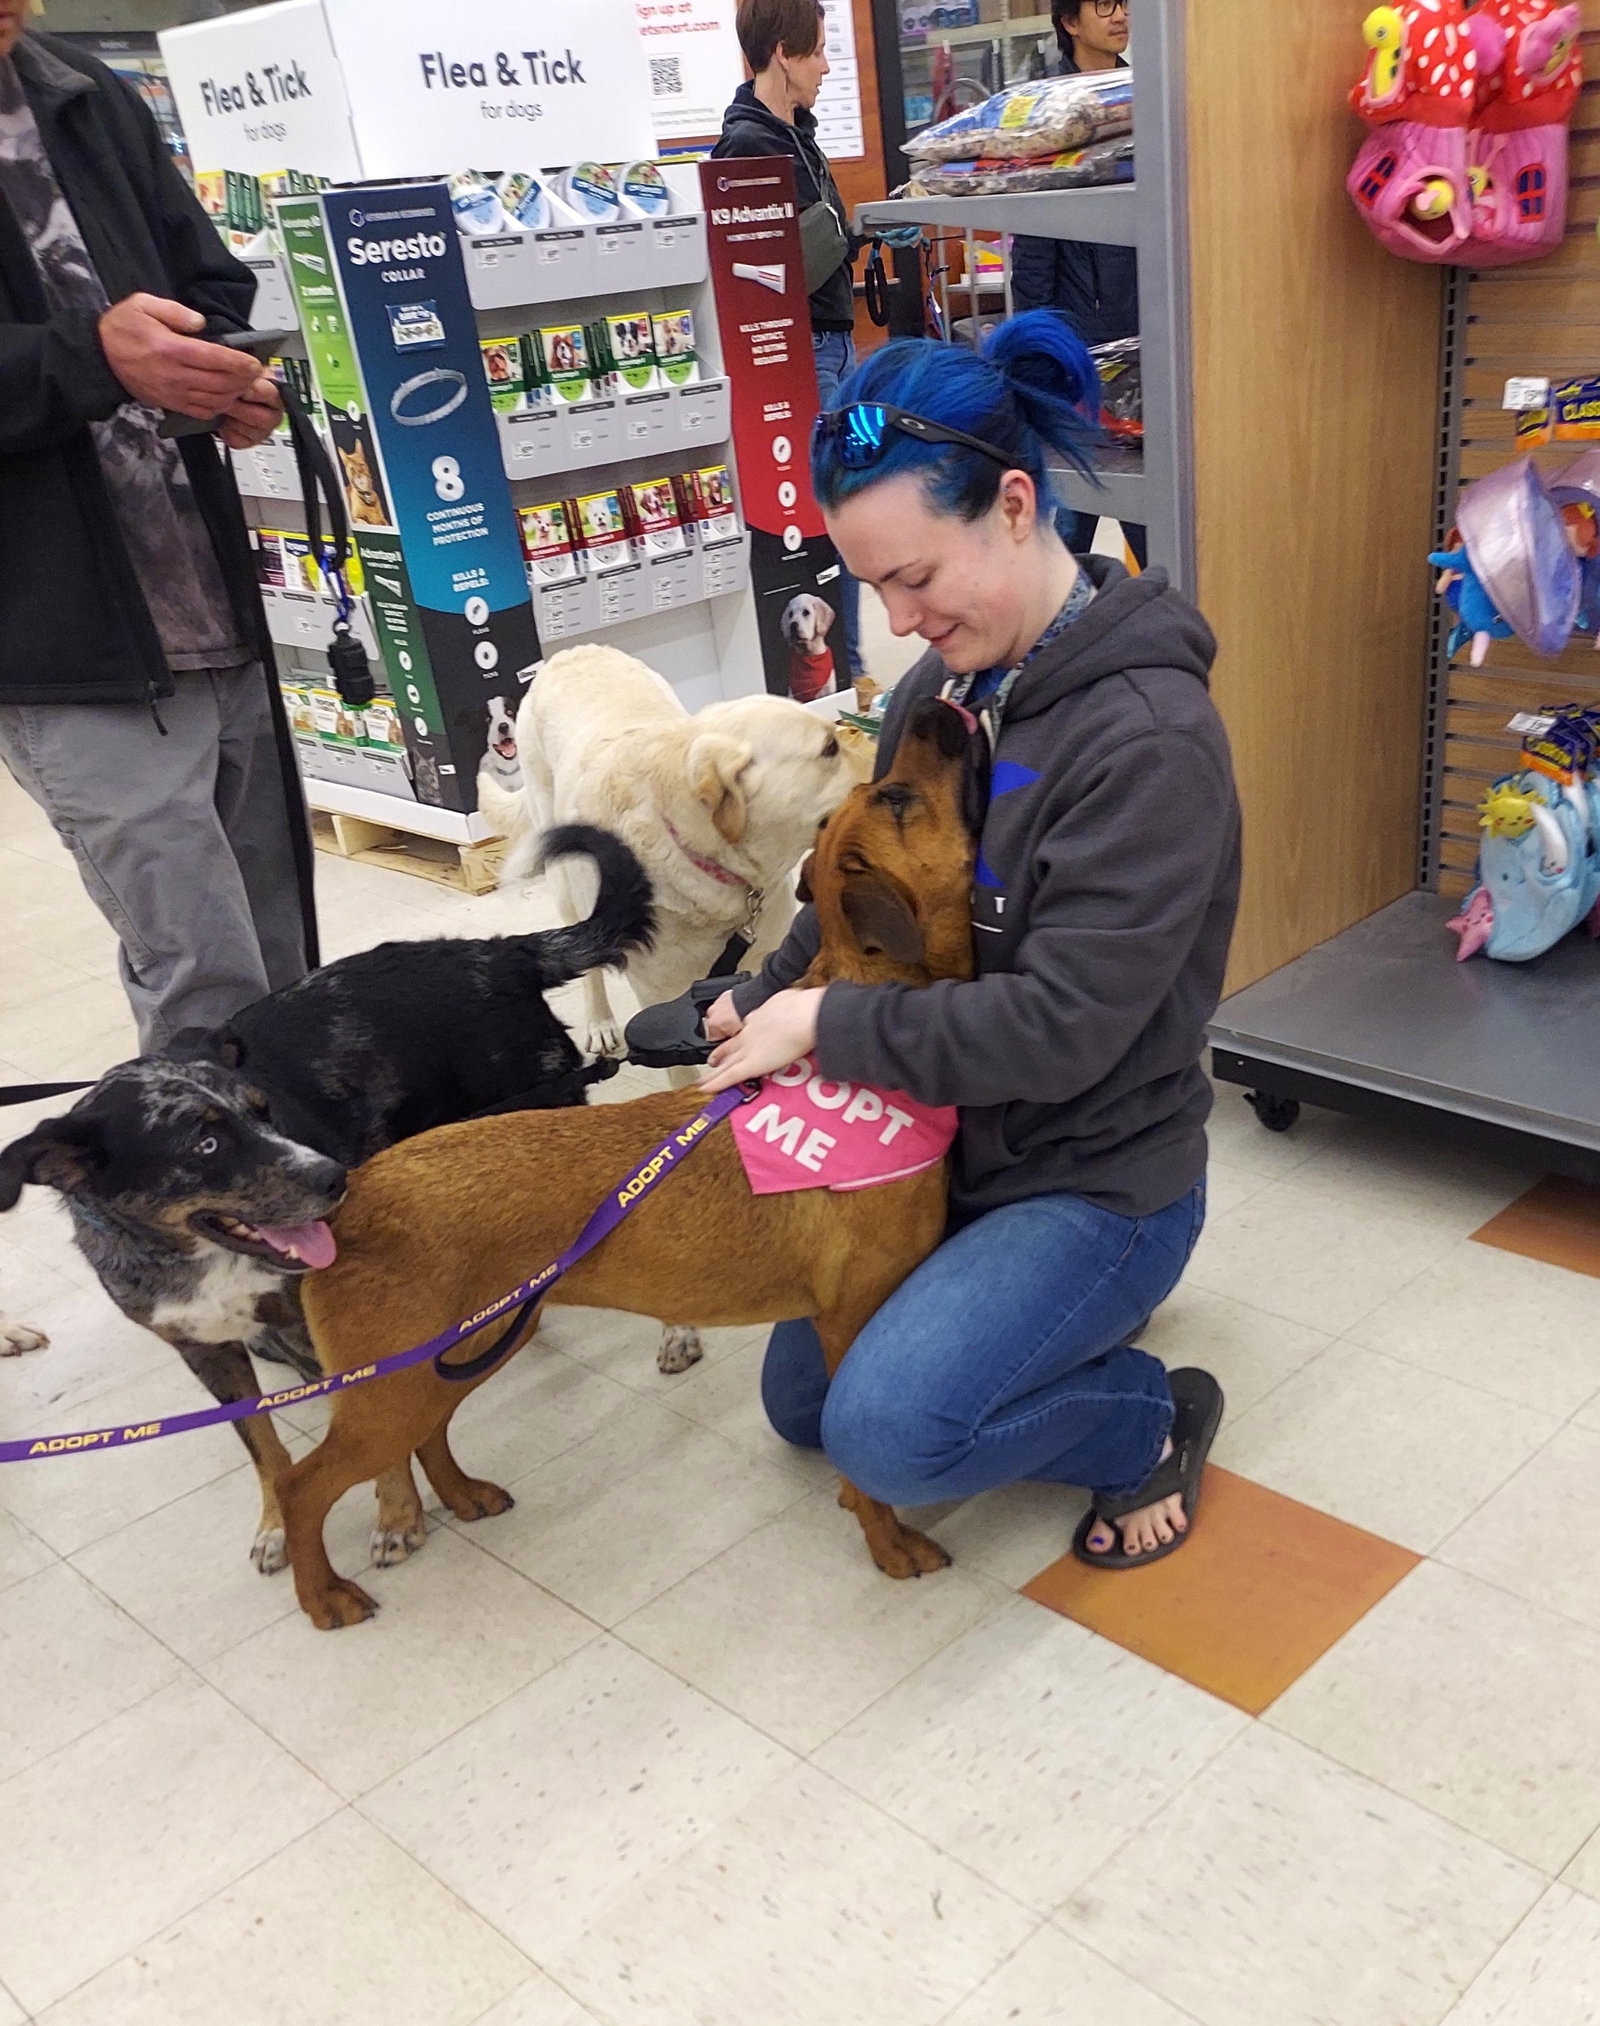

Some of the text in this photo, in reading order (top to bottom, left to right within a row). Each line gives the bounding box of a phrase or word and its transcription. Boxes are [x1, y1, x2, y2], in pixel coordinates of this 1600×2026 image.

[636, 2, 657, 19] ign
[659, 5, 675, 17] up
[640, 21, 721, 36] etsmart.com
[419, 49, 587, 89] Flea & Tick
[199, 59, 313, 117] Flea & Tick
[481, 100, 543, 122] for dogs
[243, 121, 287, 142] for dogs
[711, 208, 731, 225] K9
[348, 231, 446, 265] Seresto
[381, 268, 427, 283] COLLAR
[432, 455, 465, 501] 8
[426, 503, 485, 521] CONTINUOUS
[432, 515, 484, 533] MONTHS OF
[432, 527, 489, 546] PROTECTION
[766, 1057, 915, 1146] DOPT
[745, 1103, 837, 1173] ME
[616, 1117, 709, 1208] ADOPT ME
[459, 1263, 558, 1333] ADOPT ME
[256, 1365, 379, 1411] ADOPT ME
[29, 1422, 162, 1455] ADOPT ME
